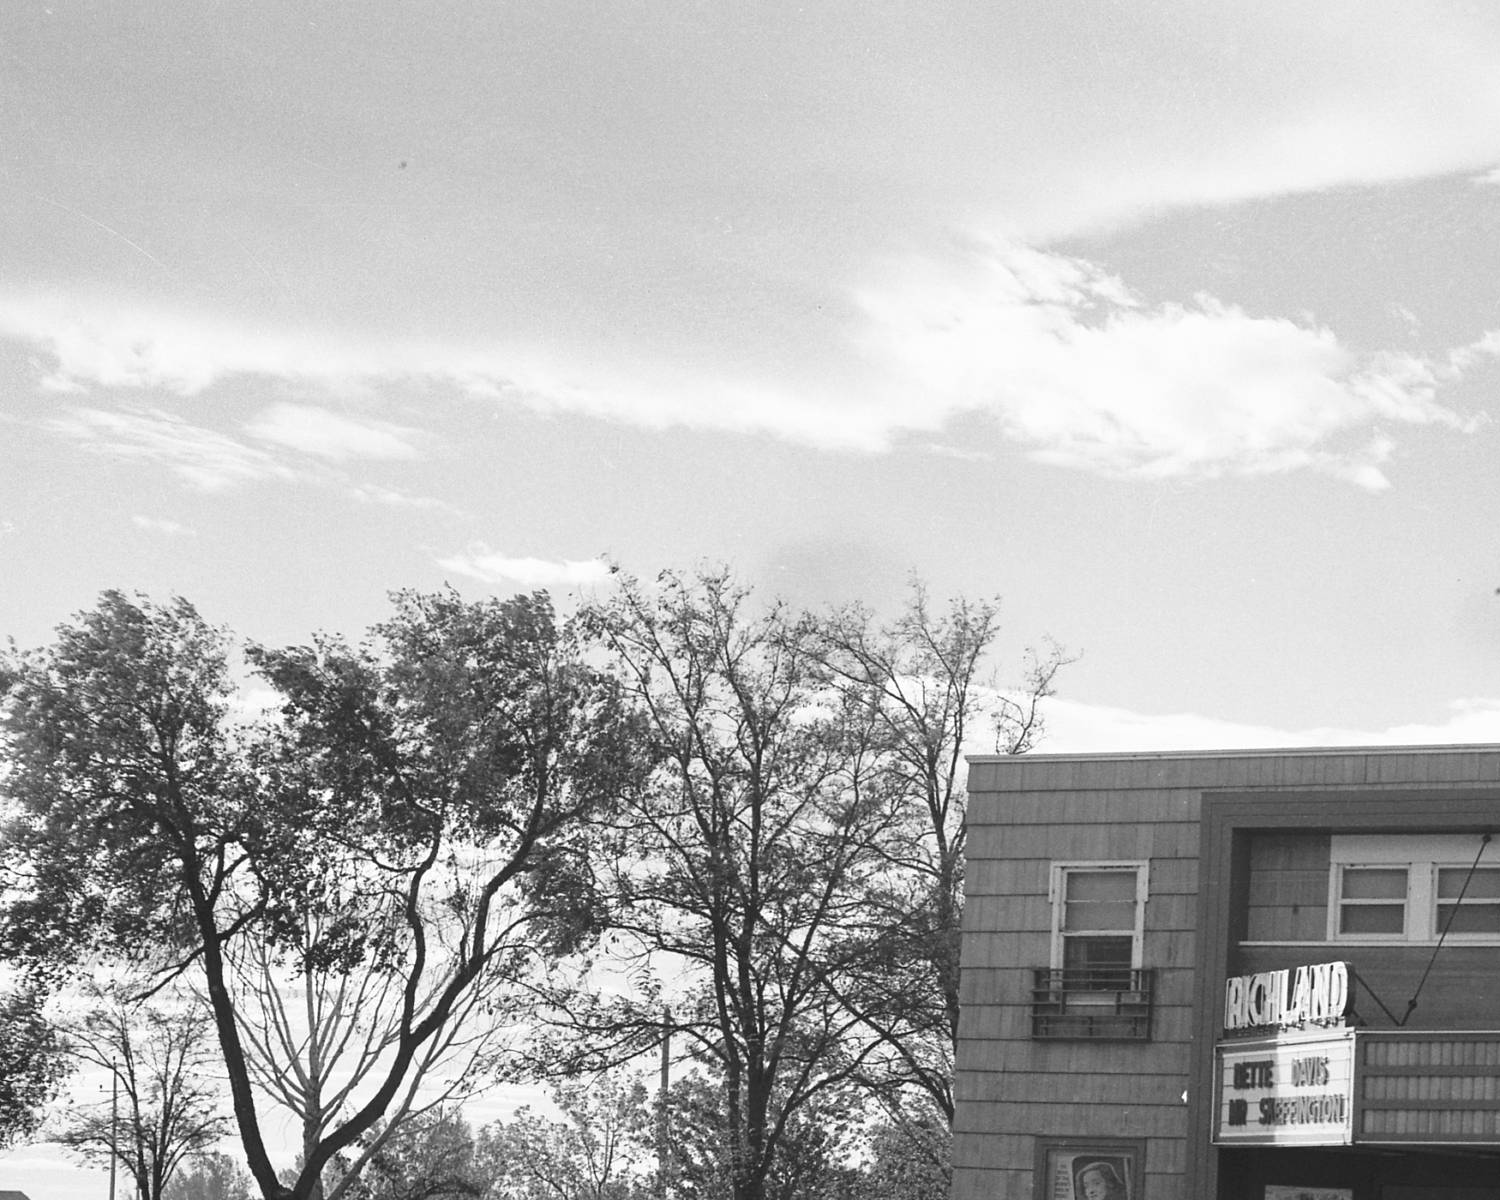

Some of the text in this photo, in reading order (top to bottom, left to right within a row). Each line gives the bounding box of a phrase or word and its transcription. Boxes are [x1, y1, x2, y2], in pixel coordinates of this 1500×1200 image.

[1223, 961, 1350, 1030] RICHLAND
[1233, 1056, 1330, 1090] BETTE DAVIS
[1258, 1094, 1346, 1126] SKEFFINGTON
